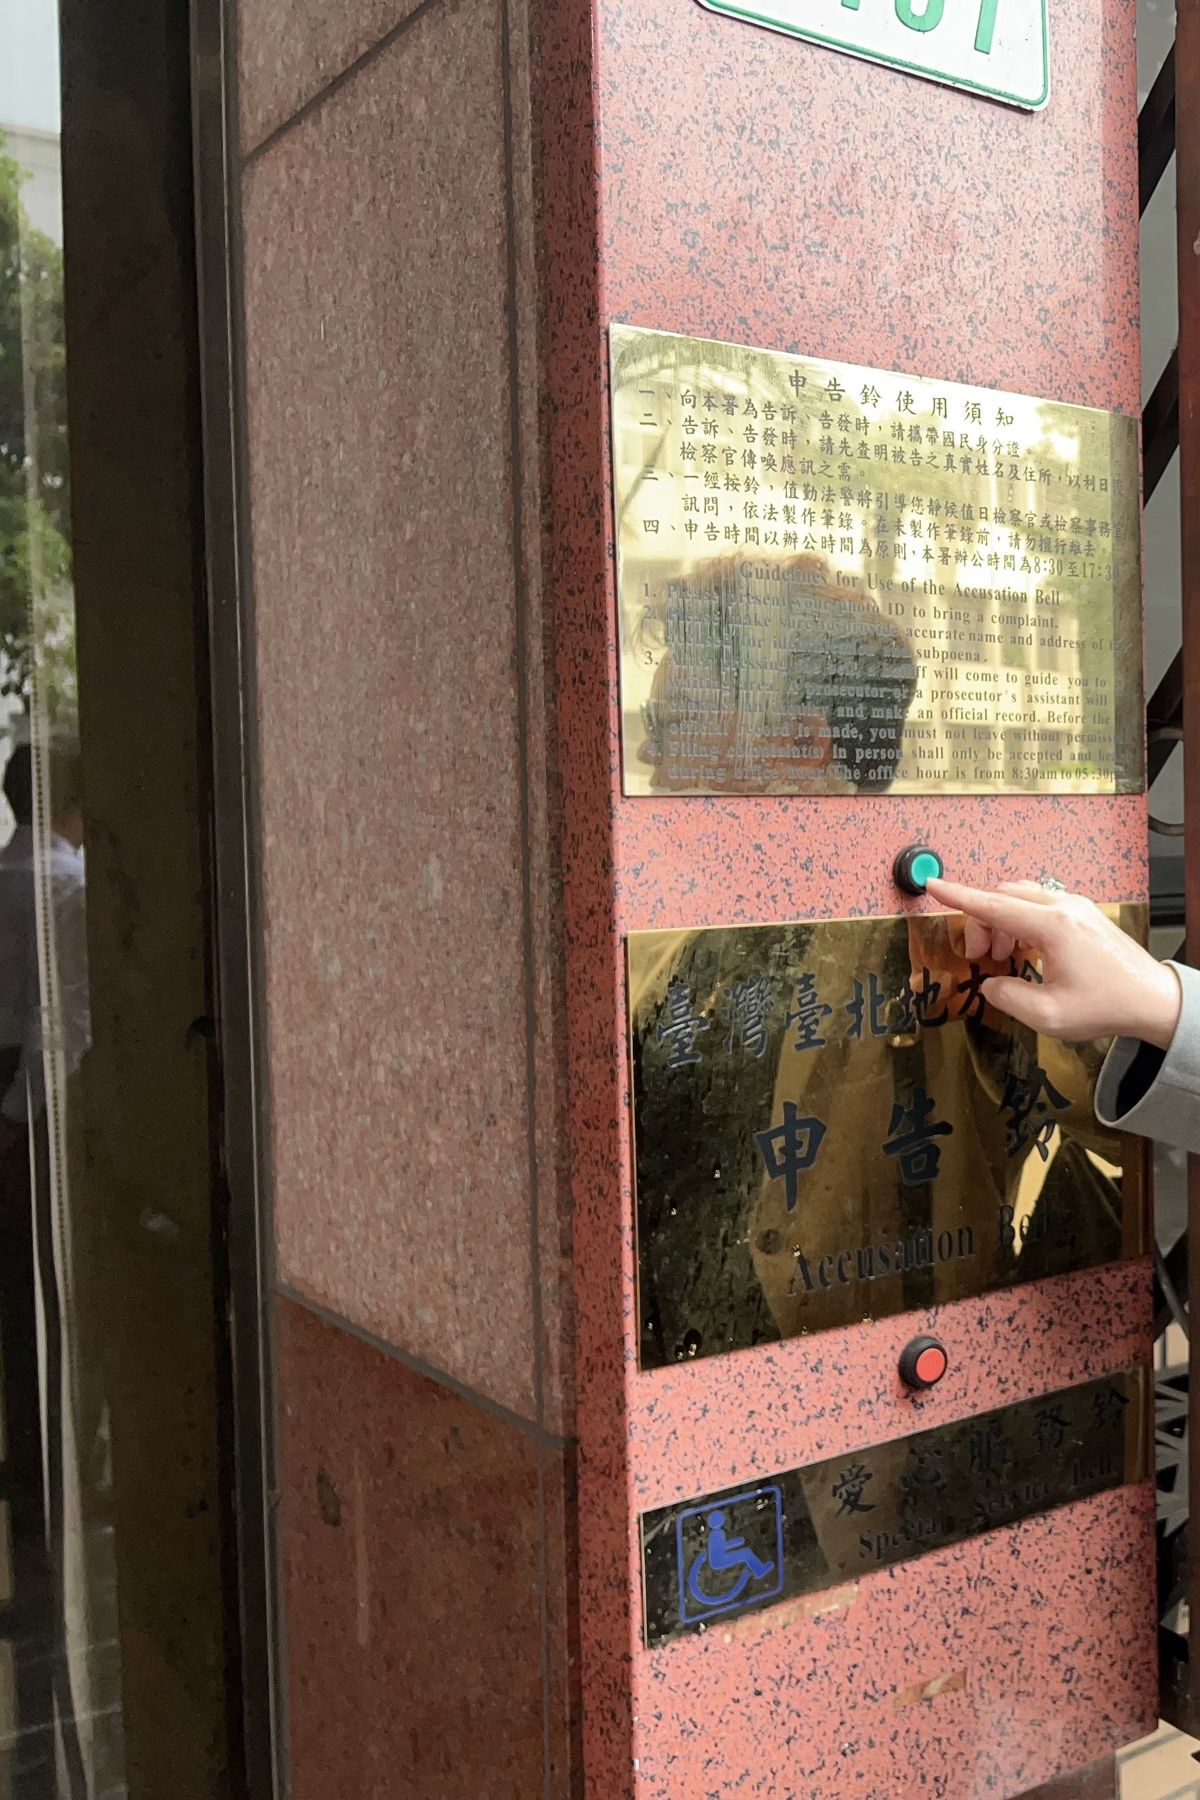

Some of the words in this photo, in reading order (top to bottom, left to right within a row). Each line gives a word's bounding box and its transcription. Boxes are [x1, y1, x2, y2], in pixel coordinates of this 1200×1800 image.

[789, 369, 1015, 427] 申告鈴使用須知
[739, 560, 828, 586] Guidelines
[836, 570, 858, 588] for
[867, 573, 894, 591] Use
[901, 577, 917, 593] of
[923, 578, 946, 596] the
[953, 581, 1028, 604] Accusation
[1035, 588, 1060, 606] Bell
[643, 583, 657, 598] 1.
[888, 602, 905, 617] ID
[913, 605, 926, 619] to
[933, 605, 970, 625] bring
[976, 612, 984, 623] a
[990, 613, 1059, 630] complaint.
[905, 627, 965, 641] accurate
[968, 632, 1004, 645] name
[1009, 633, 1033, 647] and
[1039, 635, 1087, 650] address
[1092, 638, 1105, 651] of
[916, 646, 988, 664] subpoena.
[644, 650, 659, 666] 3.
[934, 666, 959, 681] will
[965, 670, 1000, 683] come
[1005, 671, 1018, 684] to
[1024, 672, 1059, 688] guide
[1067, 676, 1089, 690] you
[1095, 676, 1107, 689] to
[805, 683, 886, 700] prosecutor
[915, 689, 923, 699] a
[931, 689, 1018, 703] prosecutor's
[1026, 691, 1081, 706] assistant
[836, 702, 866, 719] and
[870, 704, 910, 720] make
[917, 708, 934, 720] an
[941, 706, 989, 721] official
[995, 709, 1041, 724] record.
[1047, 710, 1088, 724] Before
[1092, 712, 1112, 725] the
[798, 721, 811, 738] is
[817, 723, 864, 742] made,
[869, 726, 898, 742] you
[904, 727, 937, 740] must
[945, 727, 966, 740] not
[973, 727, 1006, 741] leave
[1013, 729, 1060, 743] without
[832, 743, 848, 760] in
[855, 745, 903, 764] person
[911, 746, 944, 760] shall
[951, 746, 980, 764] only
[987, 747, 1003, 761] be
[1009, 748, 1063, 764] accepted
[1070, 750, 1092, 763] and
[916, 766, 949, 780] hour
[956, 766, 967, 780] is
[973, 766, 1005, 780] from
[1011, 766, 1058, 781] 8:30am
[1060, 767, 1072, 780] to
[754, 1066, 1071, 1213] 申告鈴
[788, 1222, 975, 1296] Accusation
